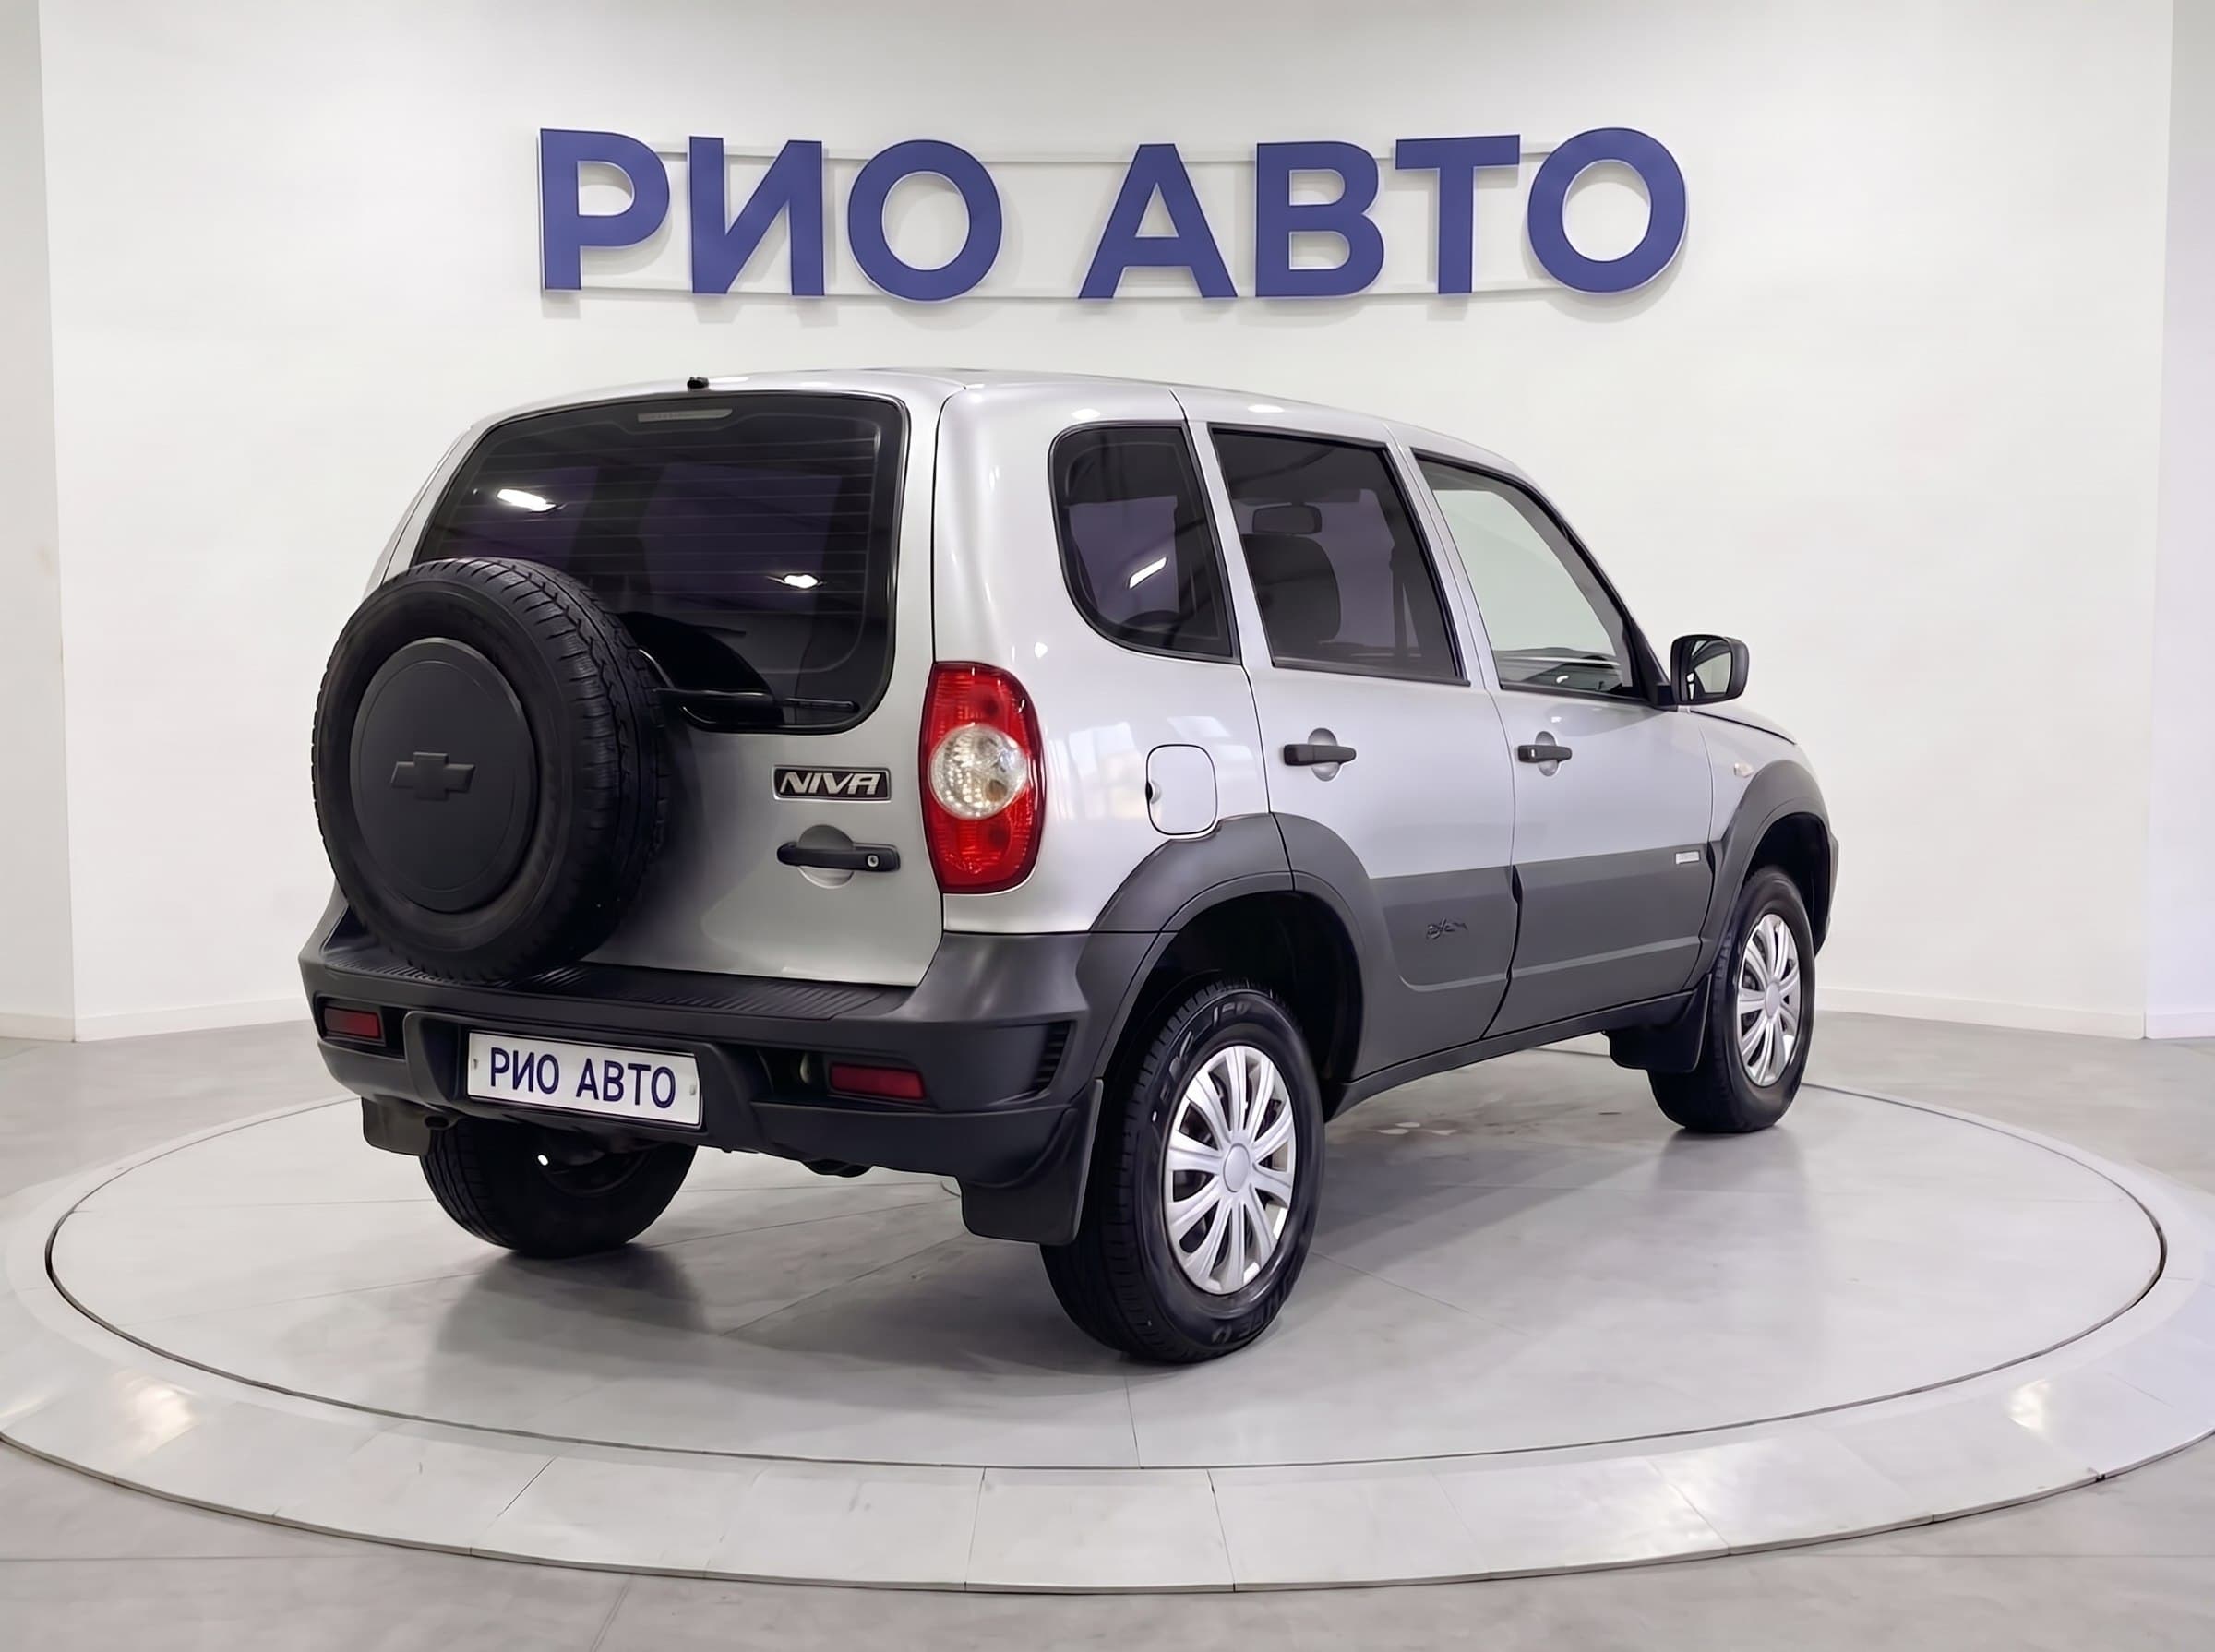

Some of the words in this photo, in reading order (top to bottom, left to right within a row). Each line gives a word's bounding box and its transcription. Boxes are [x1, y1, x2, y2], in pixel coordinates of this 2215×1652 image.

[540, 129, 1002, 301] РИО
[1078, 128, 1686, 299] АВТО
[779, 771, 880, 795] NIVA
[490, 1047, 560, 1095] РИО
[575, 1058, 676, 1109] АВТО
